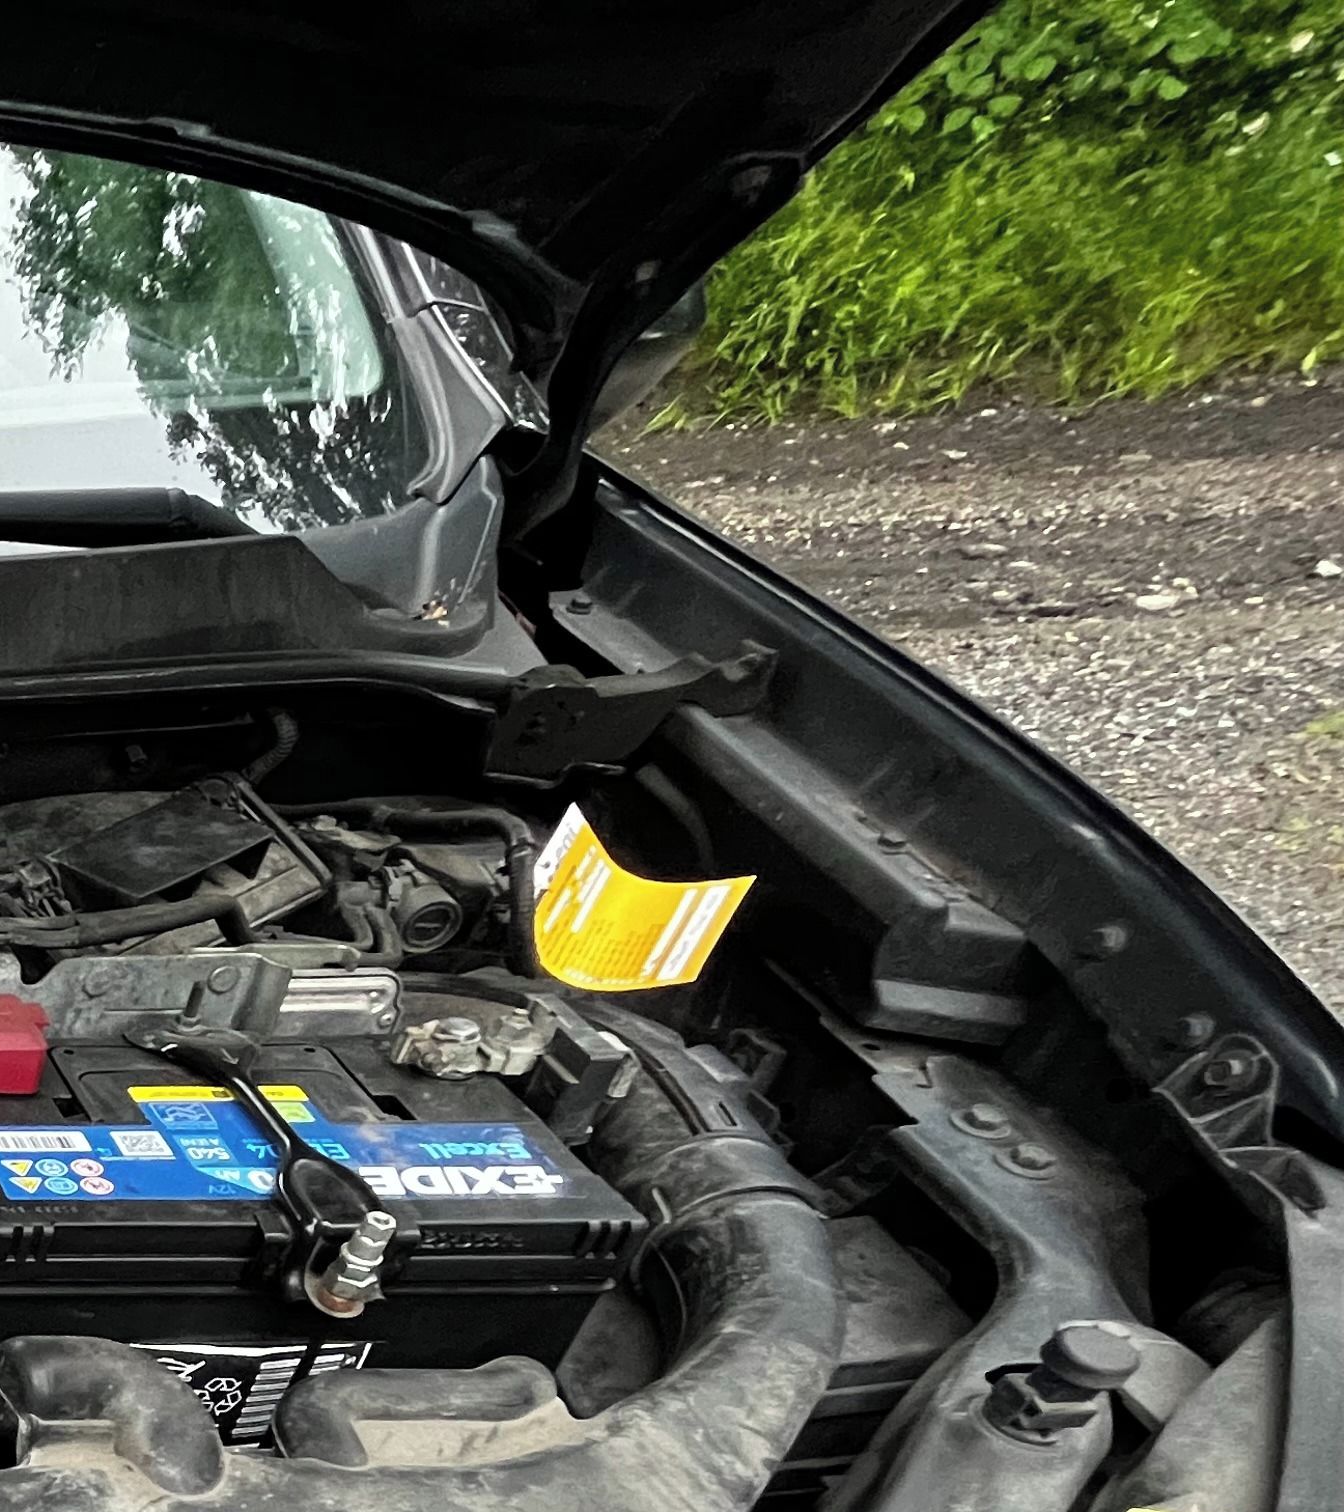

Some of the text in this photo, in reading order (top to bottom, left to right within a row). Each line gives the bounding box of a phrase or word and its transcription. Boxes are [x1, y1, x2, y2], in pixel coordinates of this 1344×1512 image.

[185, 1147, 231, 1161] 540
[419, 1143, 532, 1159] Excell
[358, 1166, 563, 1195] EXIDE
